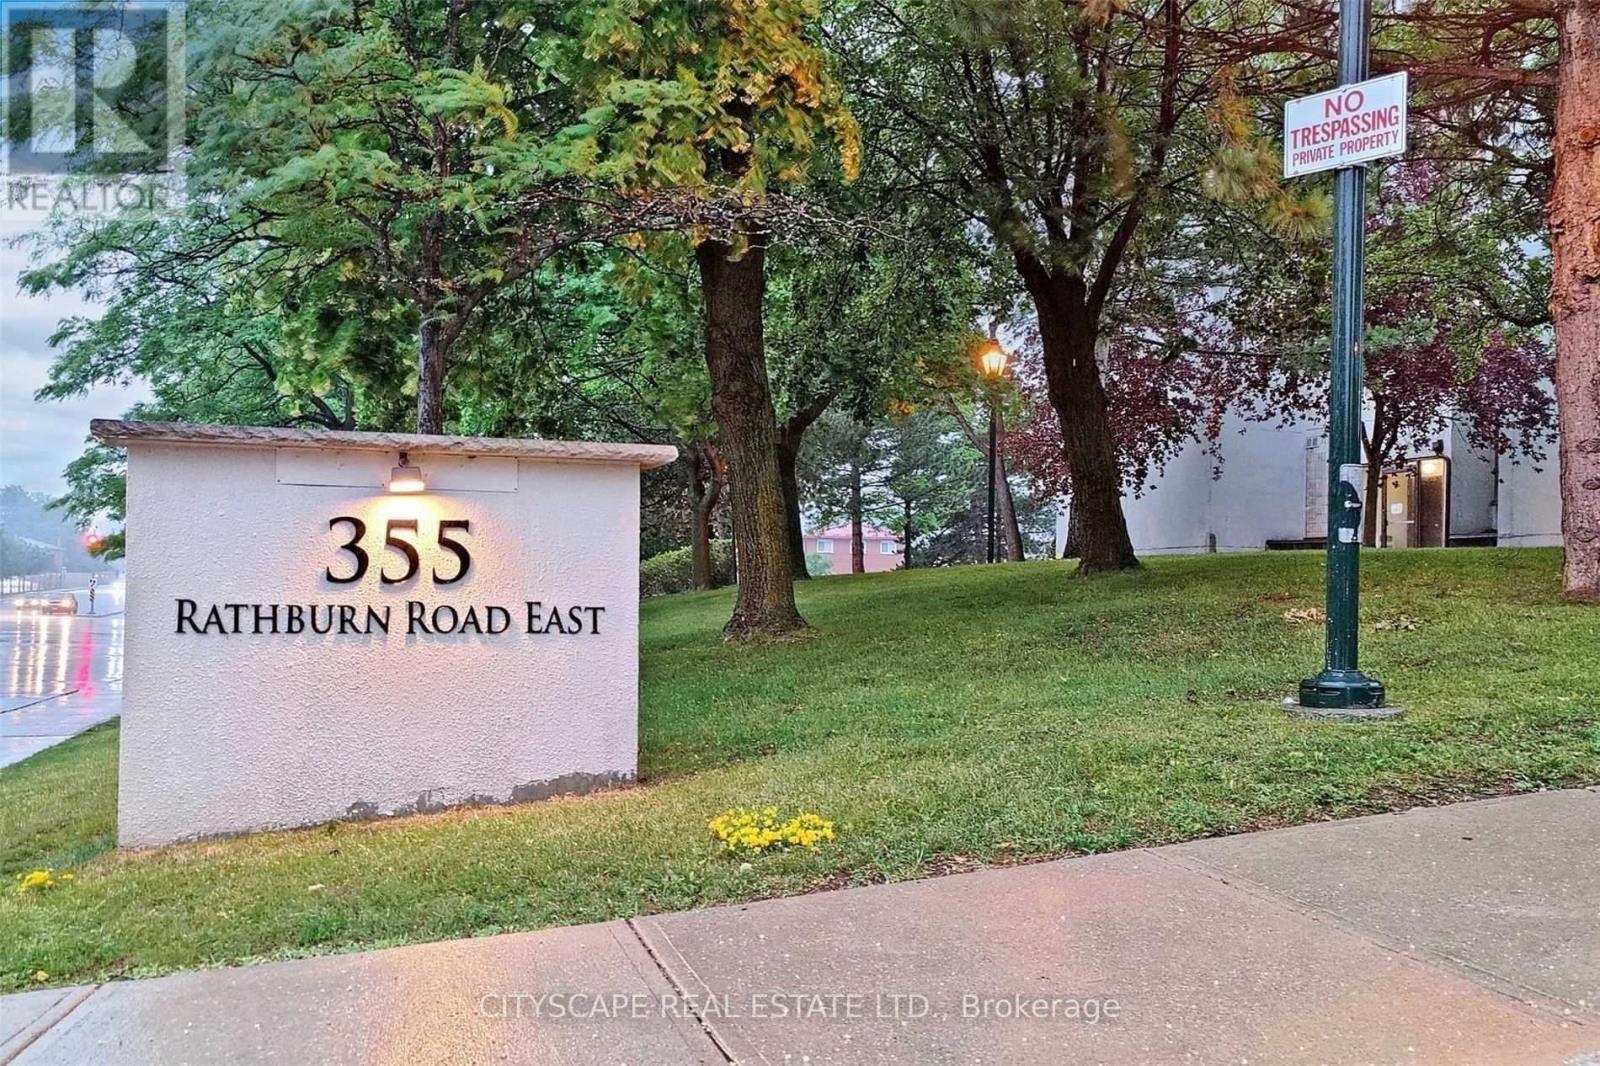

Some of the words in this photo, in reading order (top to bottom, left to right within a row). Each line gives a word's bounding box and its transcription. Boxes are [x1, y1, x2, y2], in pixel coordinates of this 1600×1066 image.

[1324, 90, 1364, 118] NO
[1290, 105, 1399, 149] TRESPASSING
[1292, 144, 1335, 167] PRIVATE
[1340, 130, 1399, 156] PROPERTY
[326, 516, 473, 585] 355
[174, 599, 391, 635] RATHBURN
[405, 601, 510, 635] ROAD
[525, 602, 606, 635] EAST
